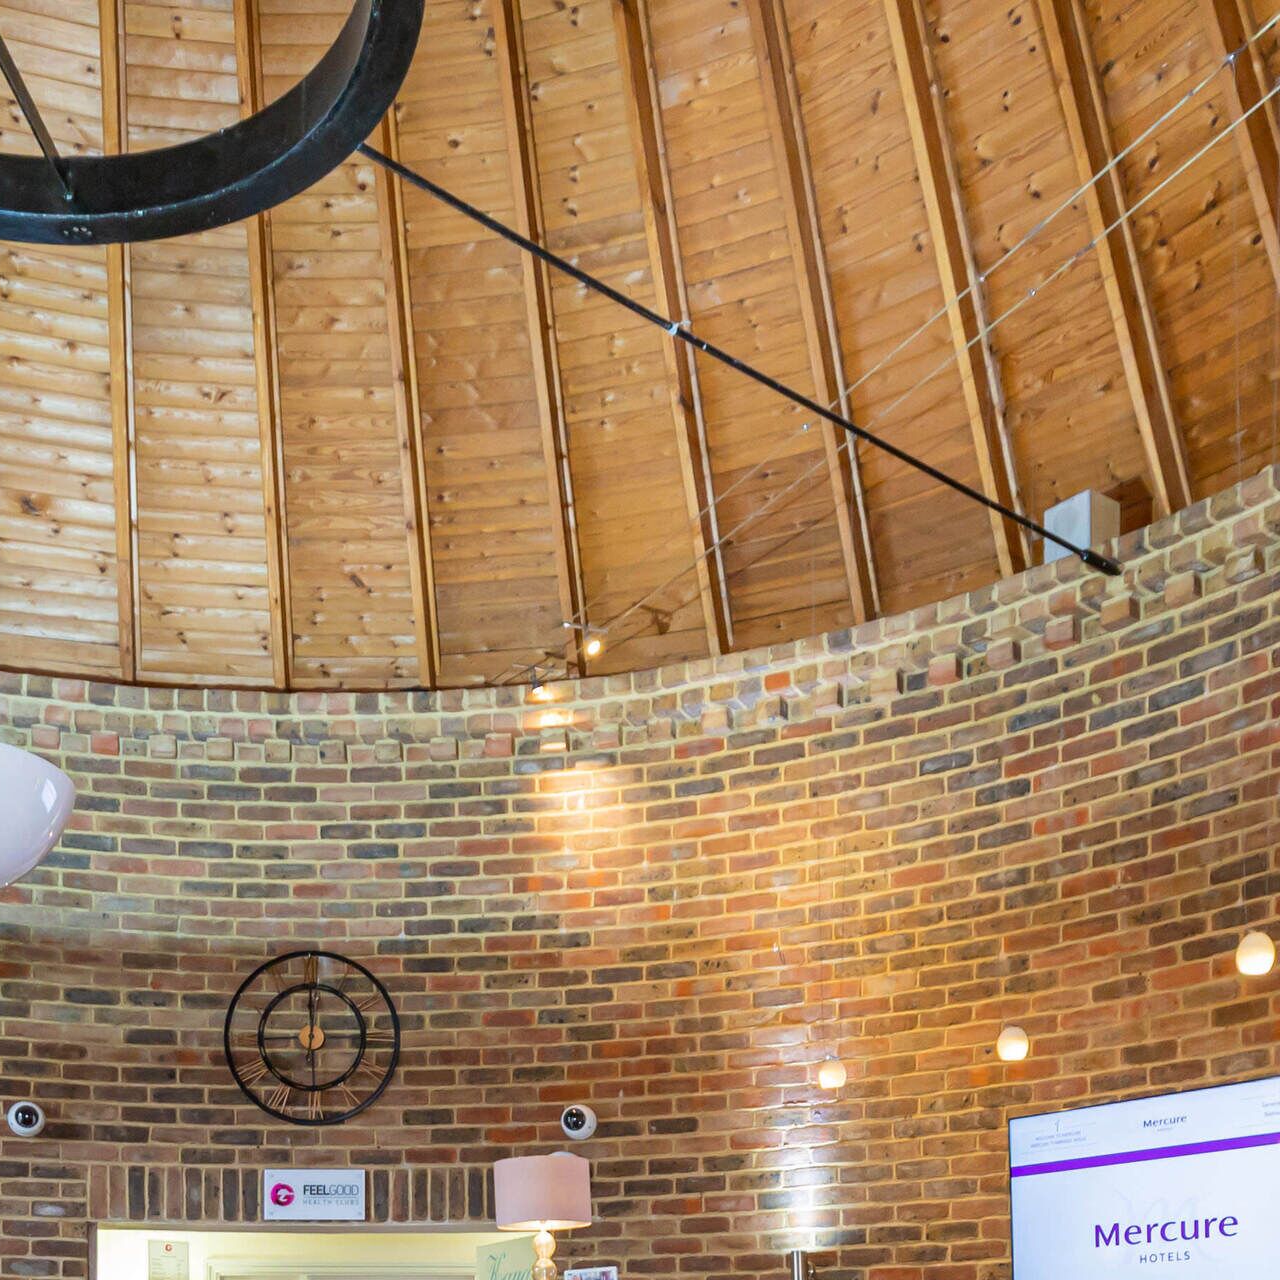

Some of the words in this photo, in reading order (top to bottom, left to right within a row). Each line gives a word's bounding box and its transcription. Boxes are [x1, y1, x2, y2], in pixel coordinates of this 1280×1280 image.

[1143, 1115, 1188, 1128] Mercure
[303, 1184, 359, 1196] FEELGOOD
[1094, 1215, 1239, 1248] Mercure
[1139, 1250, 1191, 1264] HOTELS
